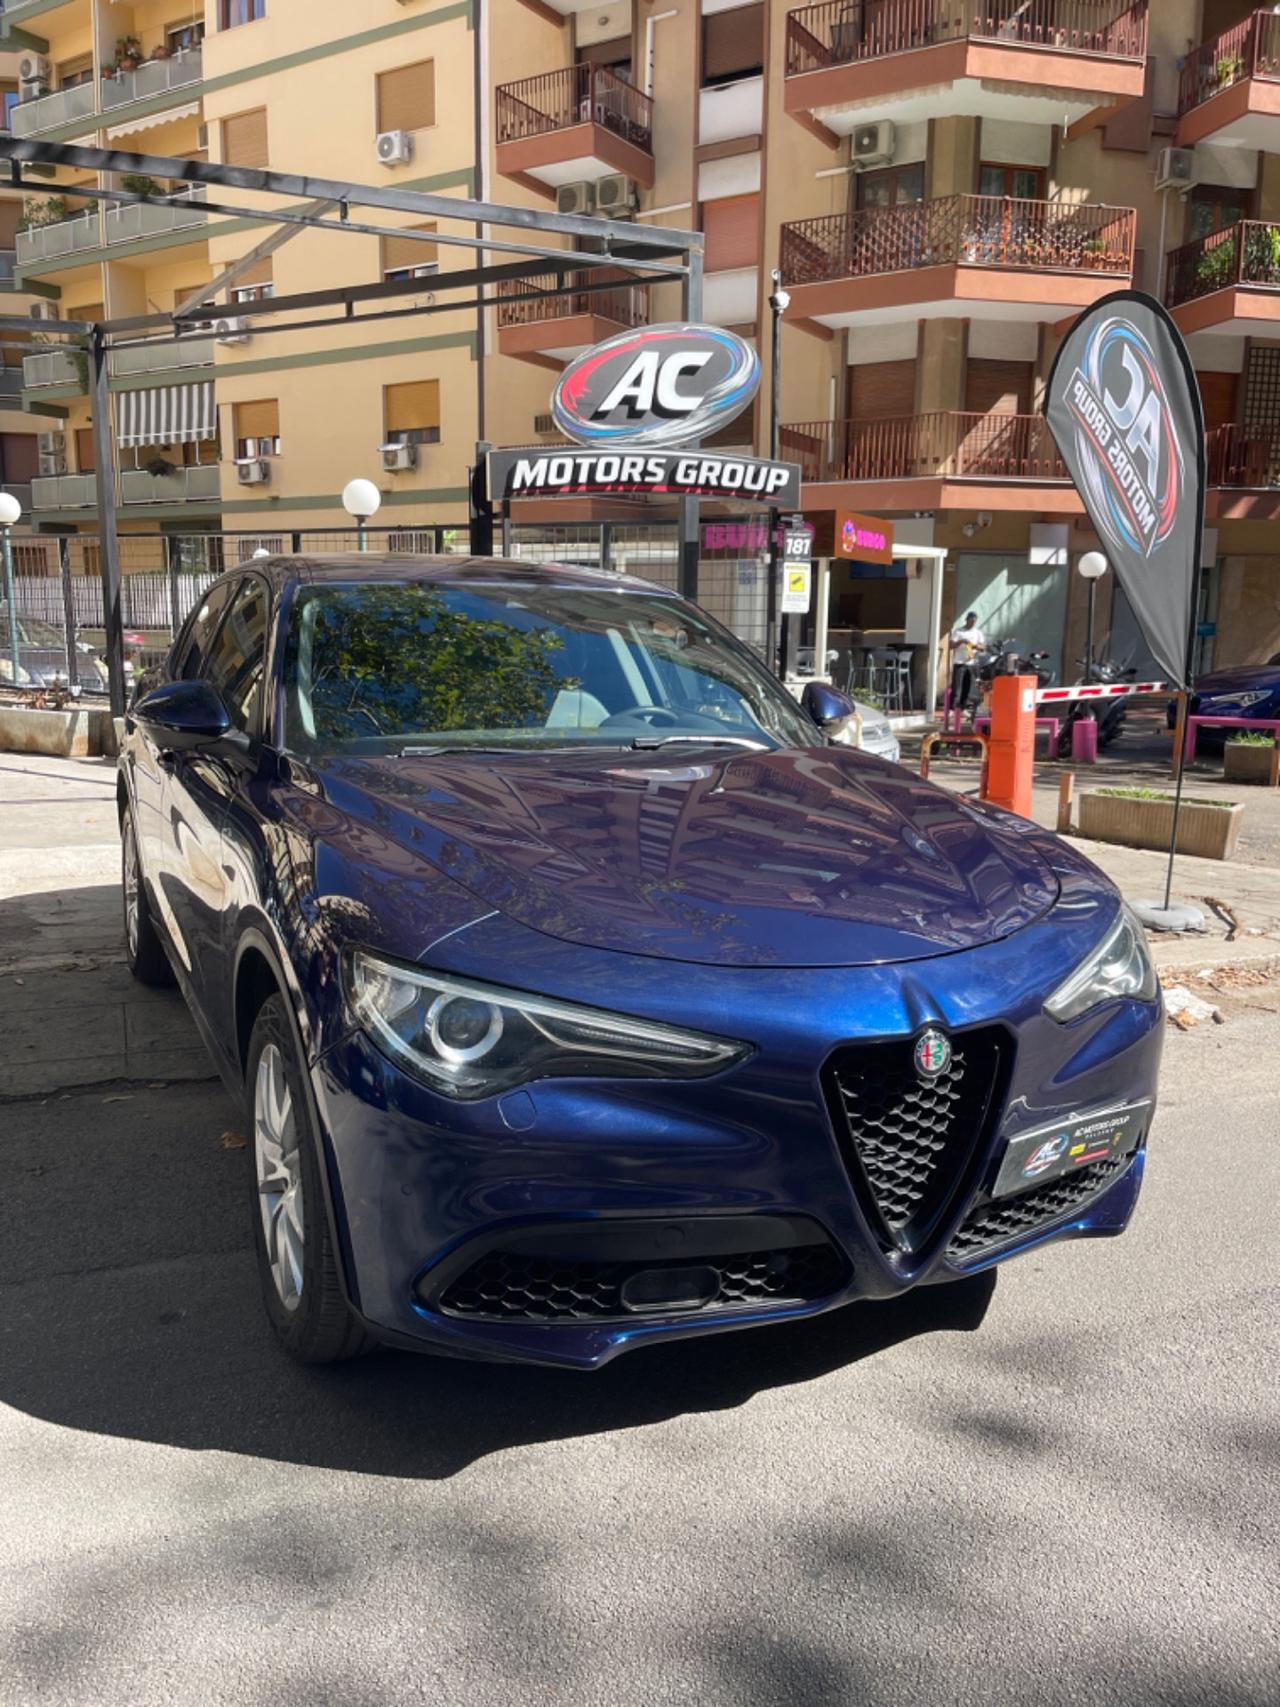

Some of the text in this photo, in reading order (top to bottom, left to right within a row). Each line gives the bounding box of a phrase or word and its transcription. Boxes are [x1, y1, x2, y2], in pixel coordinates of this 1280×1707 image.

[597, 350, 714, 412] AC
[512, 456, 790, 494] MOTORS GROUP
[785, 538, 811, 555] 181
